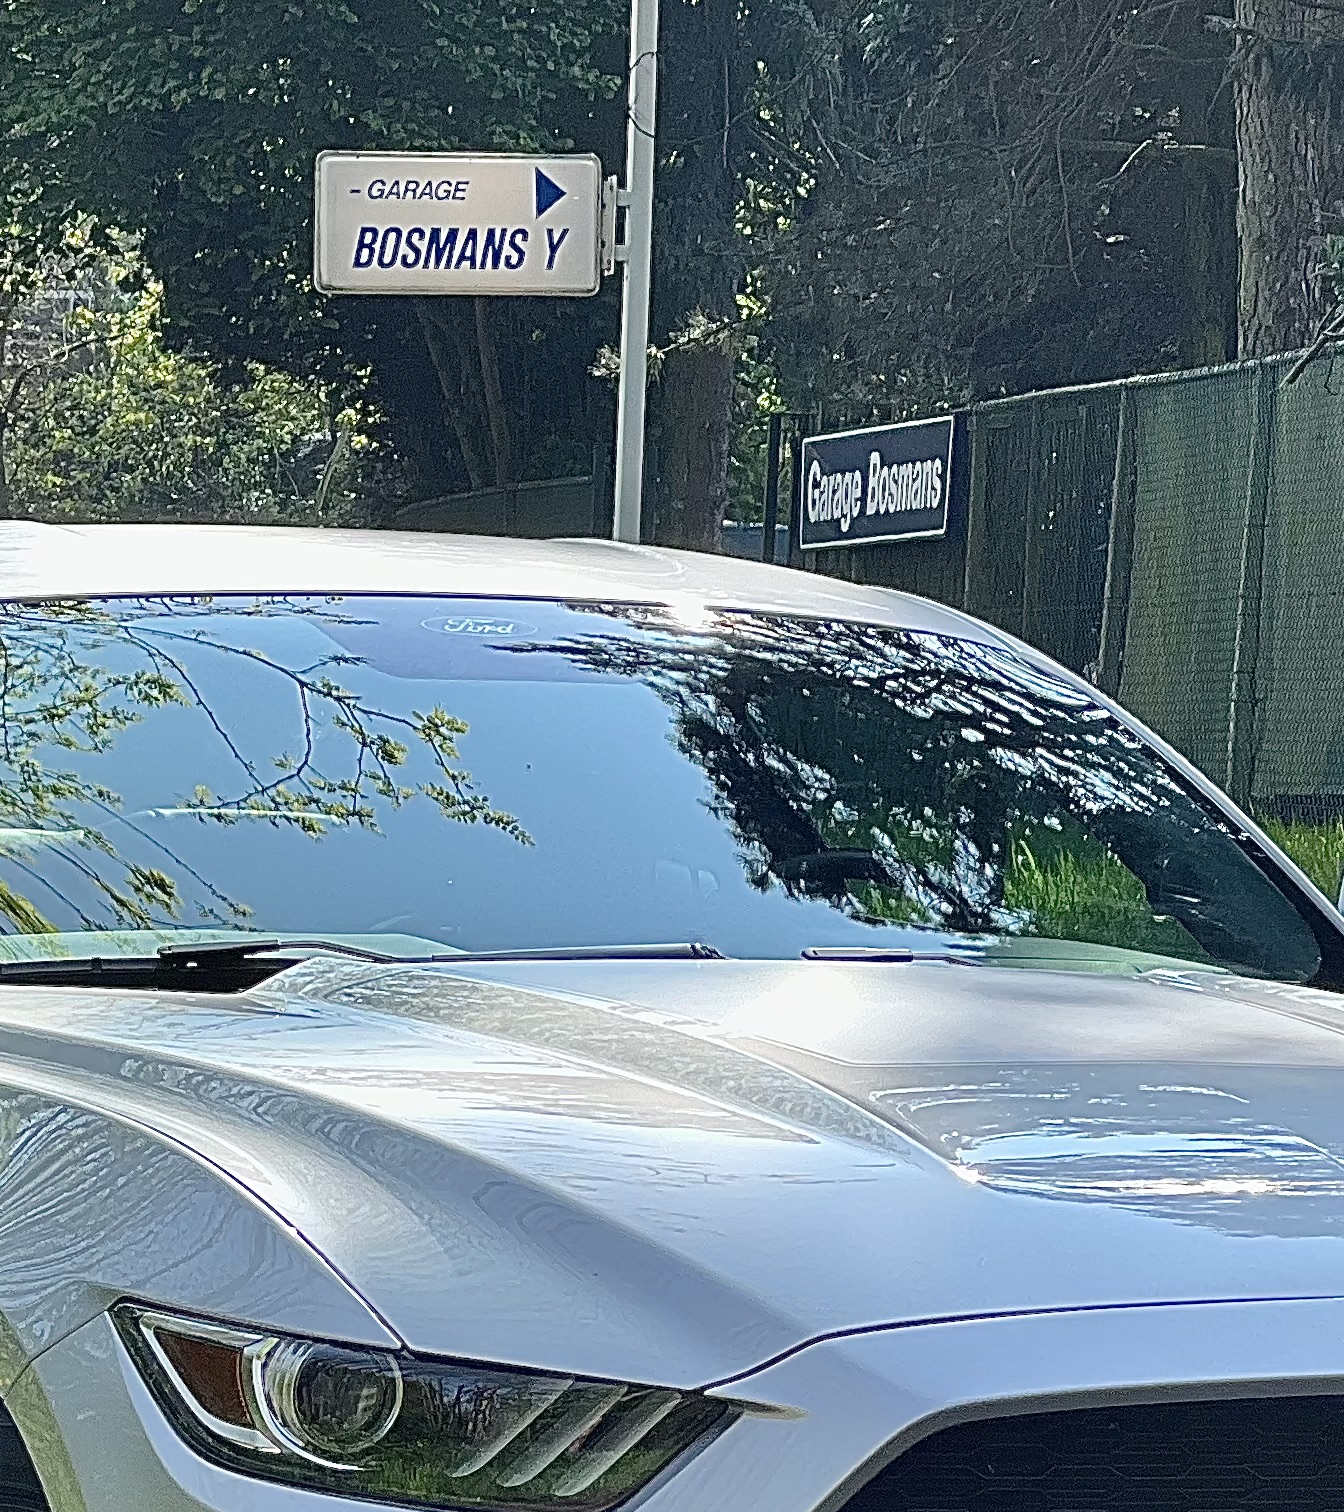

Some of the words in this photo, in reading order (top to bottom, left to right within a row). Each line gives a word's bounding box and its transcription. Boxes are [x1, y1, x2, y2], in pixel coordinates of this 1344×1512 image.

[367, 179, 470, 201] GARAGE
[352, 227, 529, 270] BOSMANS
[545, 228, 570, 271] Y
[807, 459, 862, 533] Garage
[866, 451, 942, 516] Bosmans
[443, 618, 514, 634] Ford
